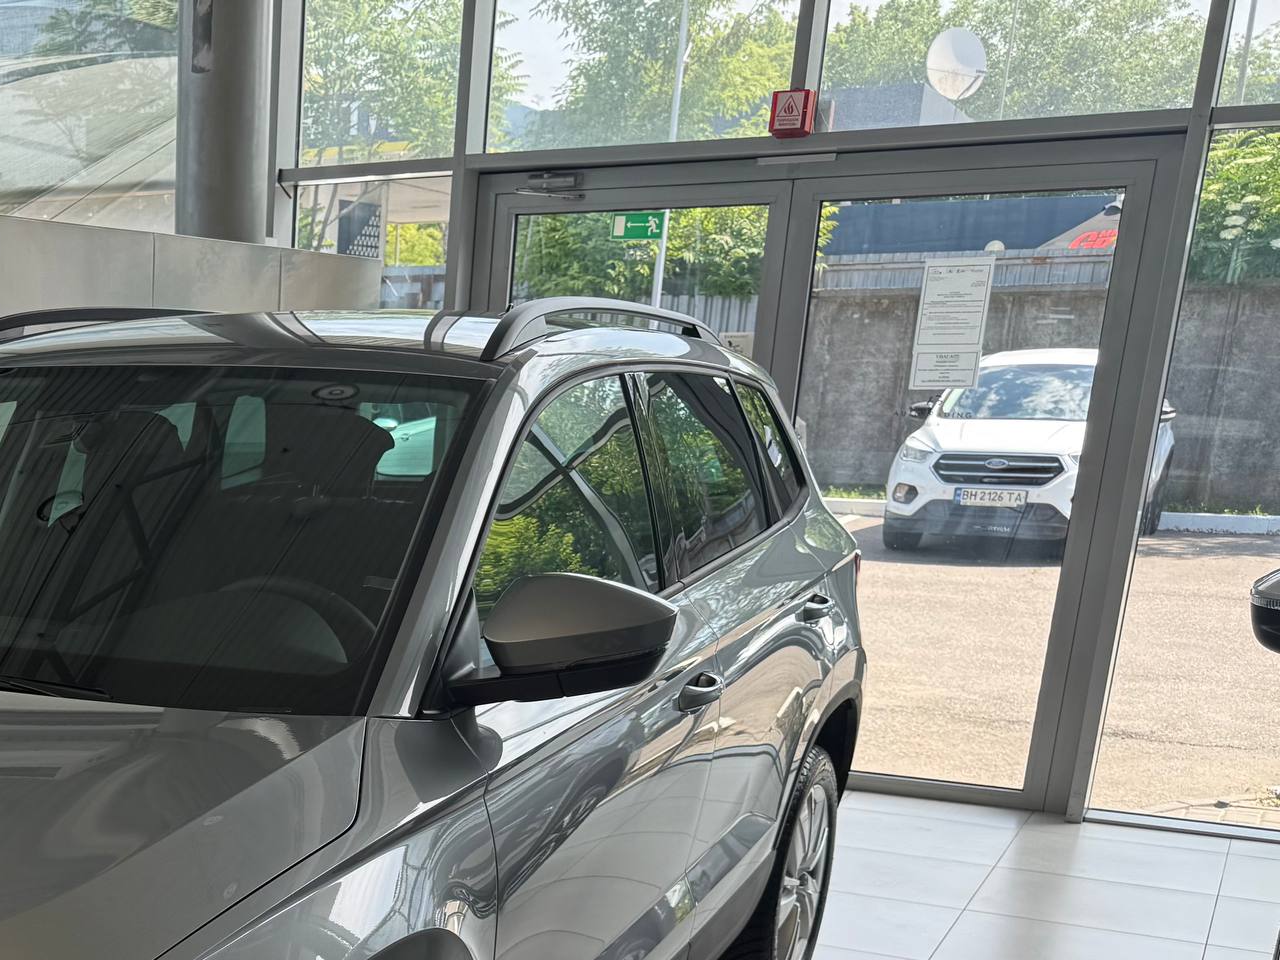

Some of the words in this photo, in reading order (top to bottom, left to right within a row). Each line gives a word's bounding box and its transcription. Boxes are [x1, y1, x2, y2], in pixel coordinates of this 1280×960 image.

[962, 489, 978, 501] BH
[979, 490, 1005, 502] 2126
[1006, 492, 1022, 503] TA
